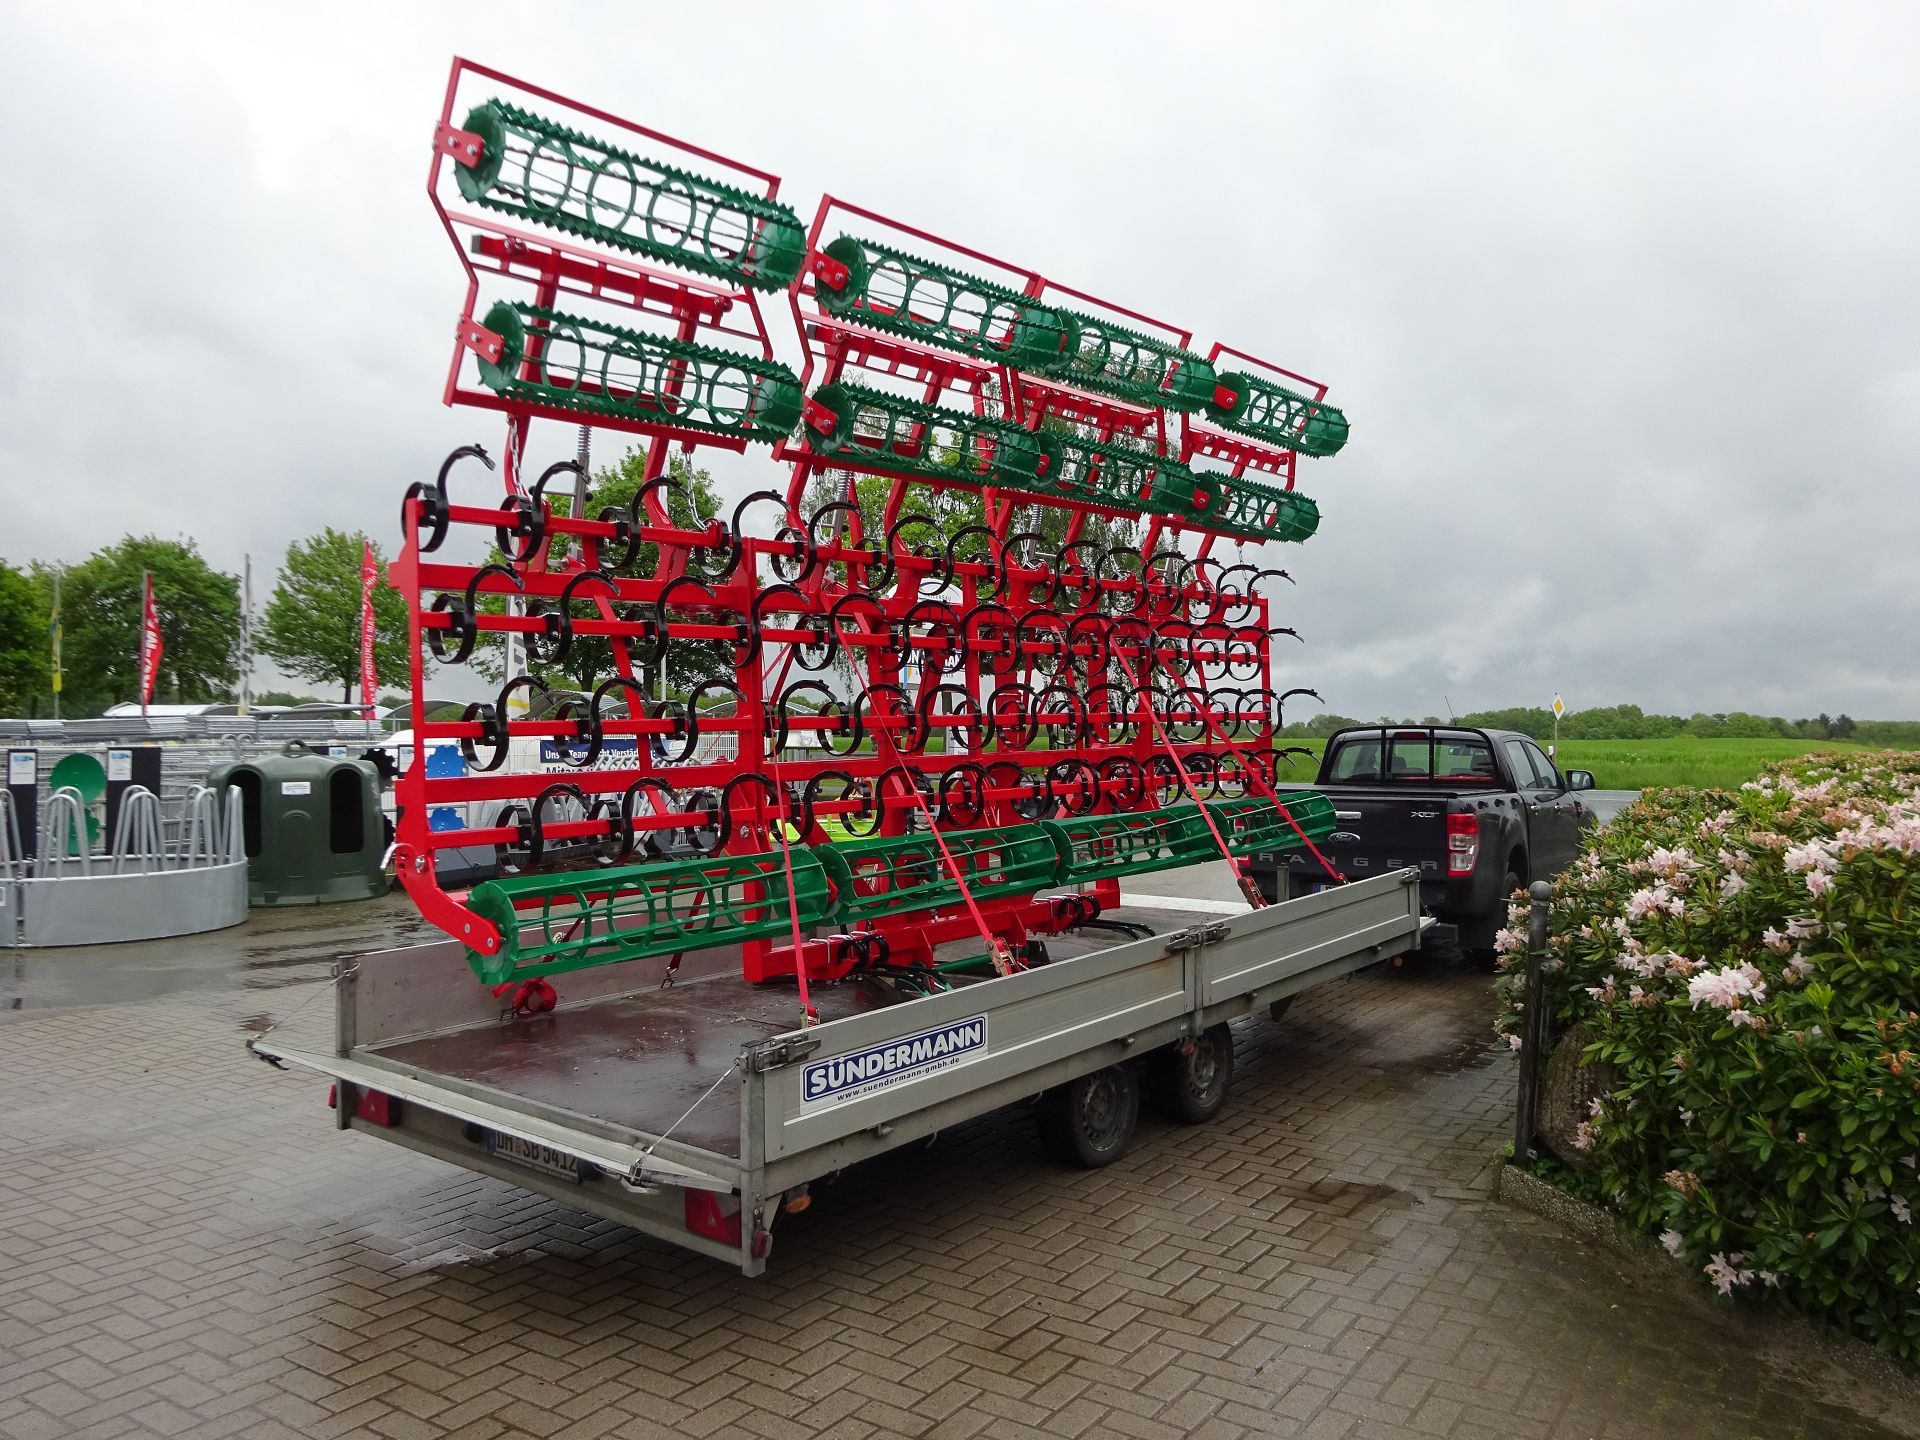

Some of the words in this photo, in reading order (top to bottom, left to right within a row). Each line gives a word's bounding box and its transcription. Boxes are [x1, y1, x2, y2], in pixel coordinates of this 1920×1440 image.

[545, 750, 560, 760] Uns
[1411, 811, 1440, 819] XLT
[1334, 833, 1353, 843] Ford
[810, 1022, 981, 1094] SÜNDERMANN
[837, 1056, 960, 1101] www.suendermann-gmbh.de
